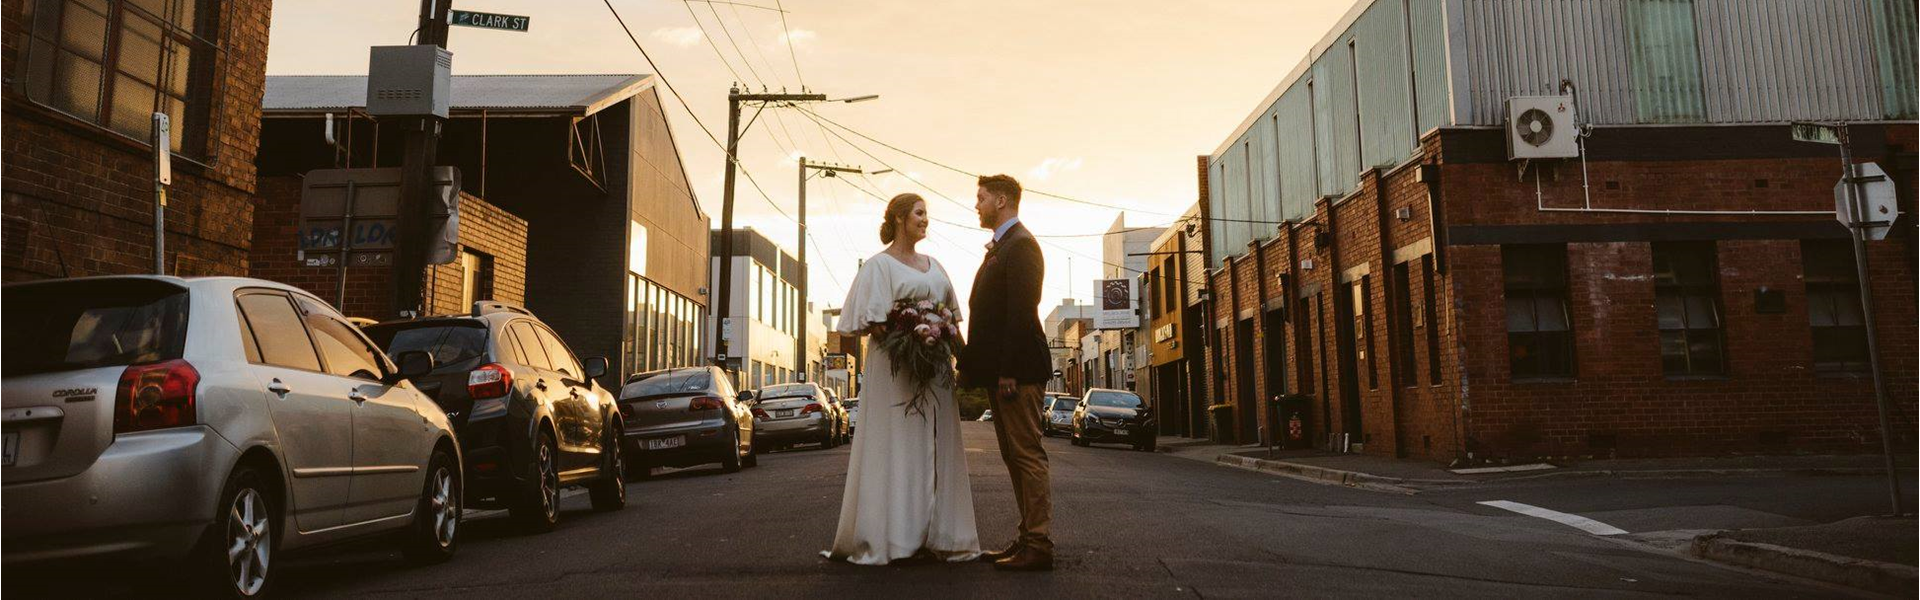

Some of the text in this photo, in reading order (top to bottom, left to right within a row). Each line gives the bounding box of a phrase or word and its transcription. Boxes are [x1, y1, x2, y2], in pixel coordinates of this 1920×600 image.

[472, 13, 527, 30] CLARK ST
[52, 387, 97, 398] COROLLA
